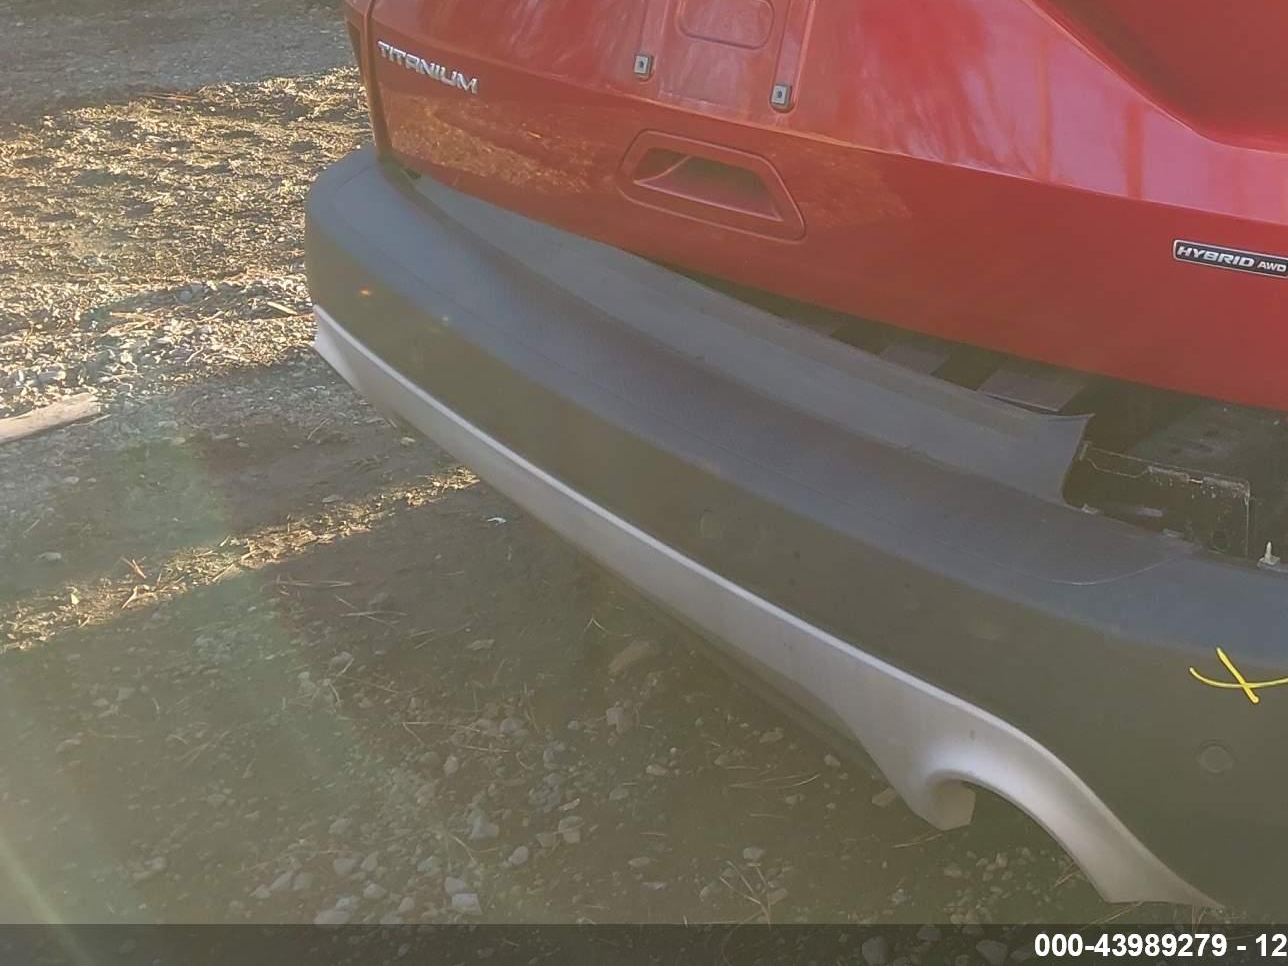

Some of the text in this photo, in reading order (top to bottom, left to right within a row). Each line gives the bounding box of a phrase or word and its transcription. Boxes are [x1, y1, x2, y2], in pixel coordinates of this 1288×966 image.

[378, 40, 478, 94] TITANIUM
[1177, 245, 1287, 273] HYBRID AWD
